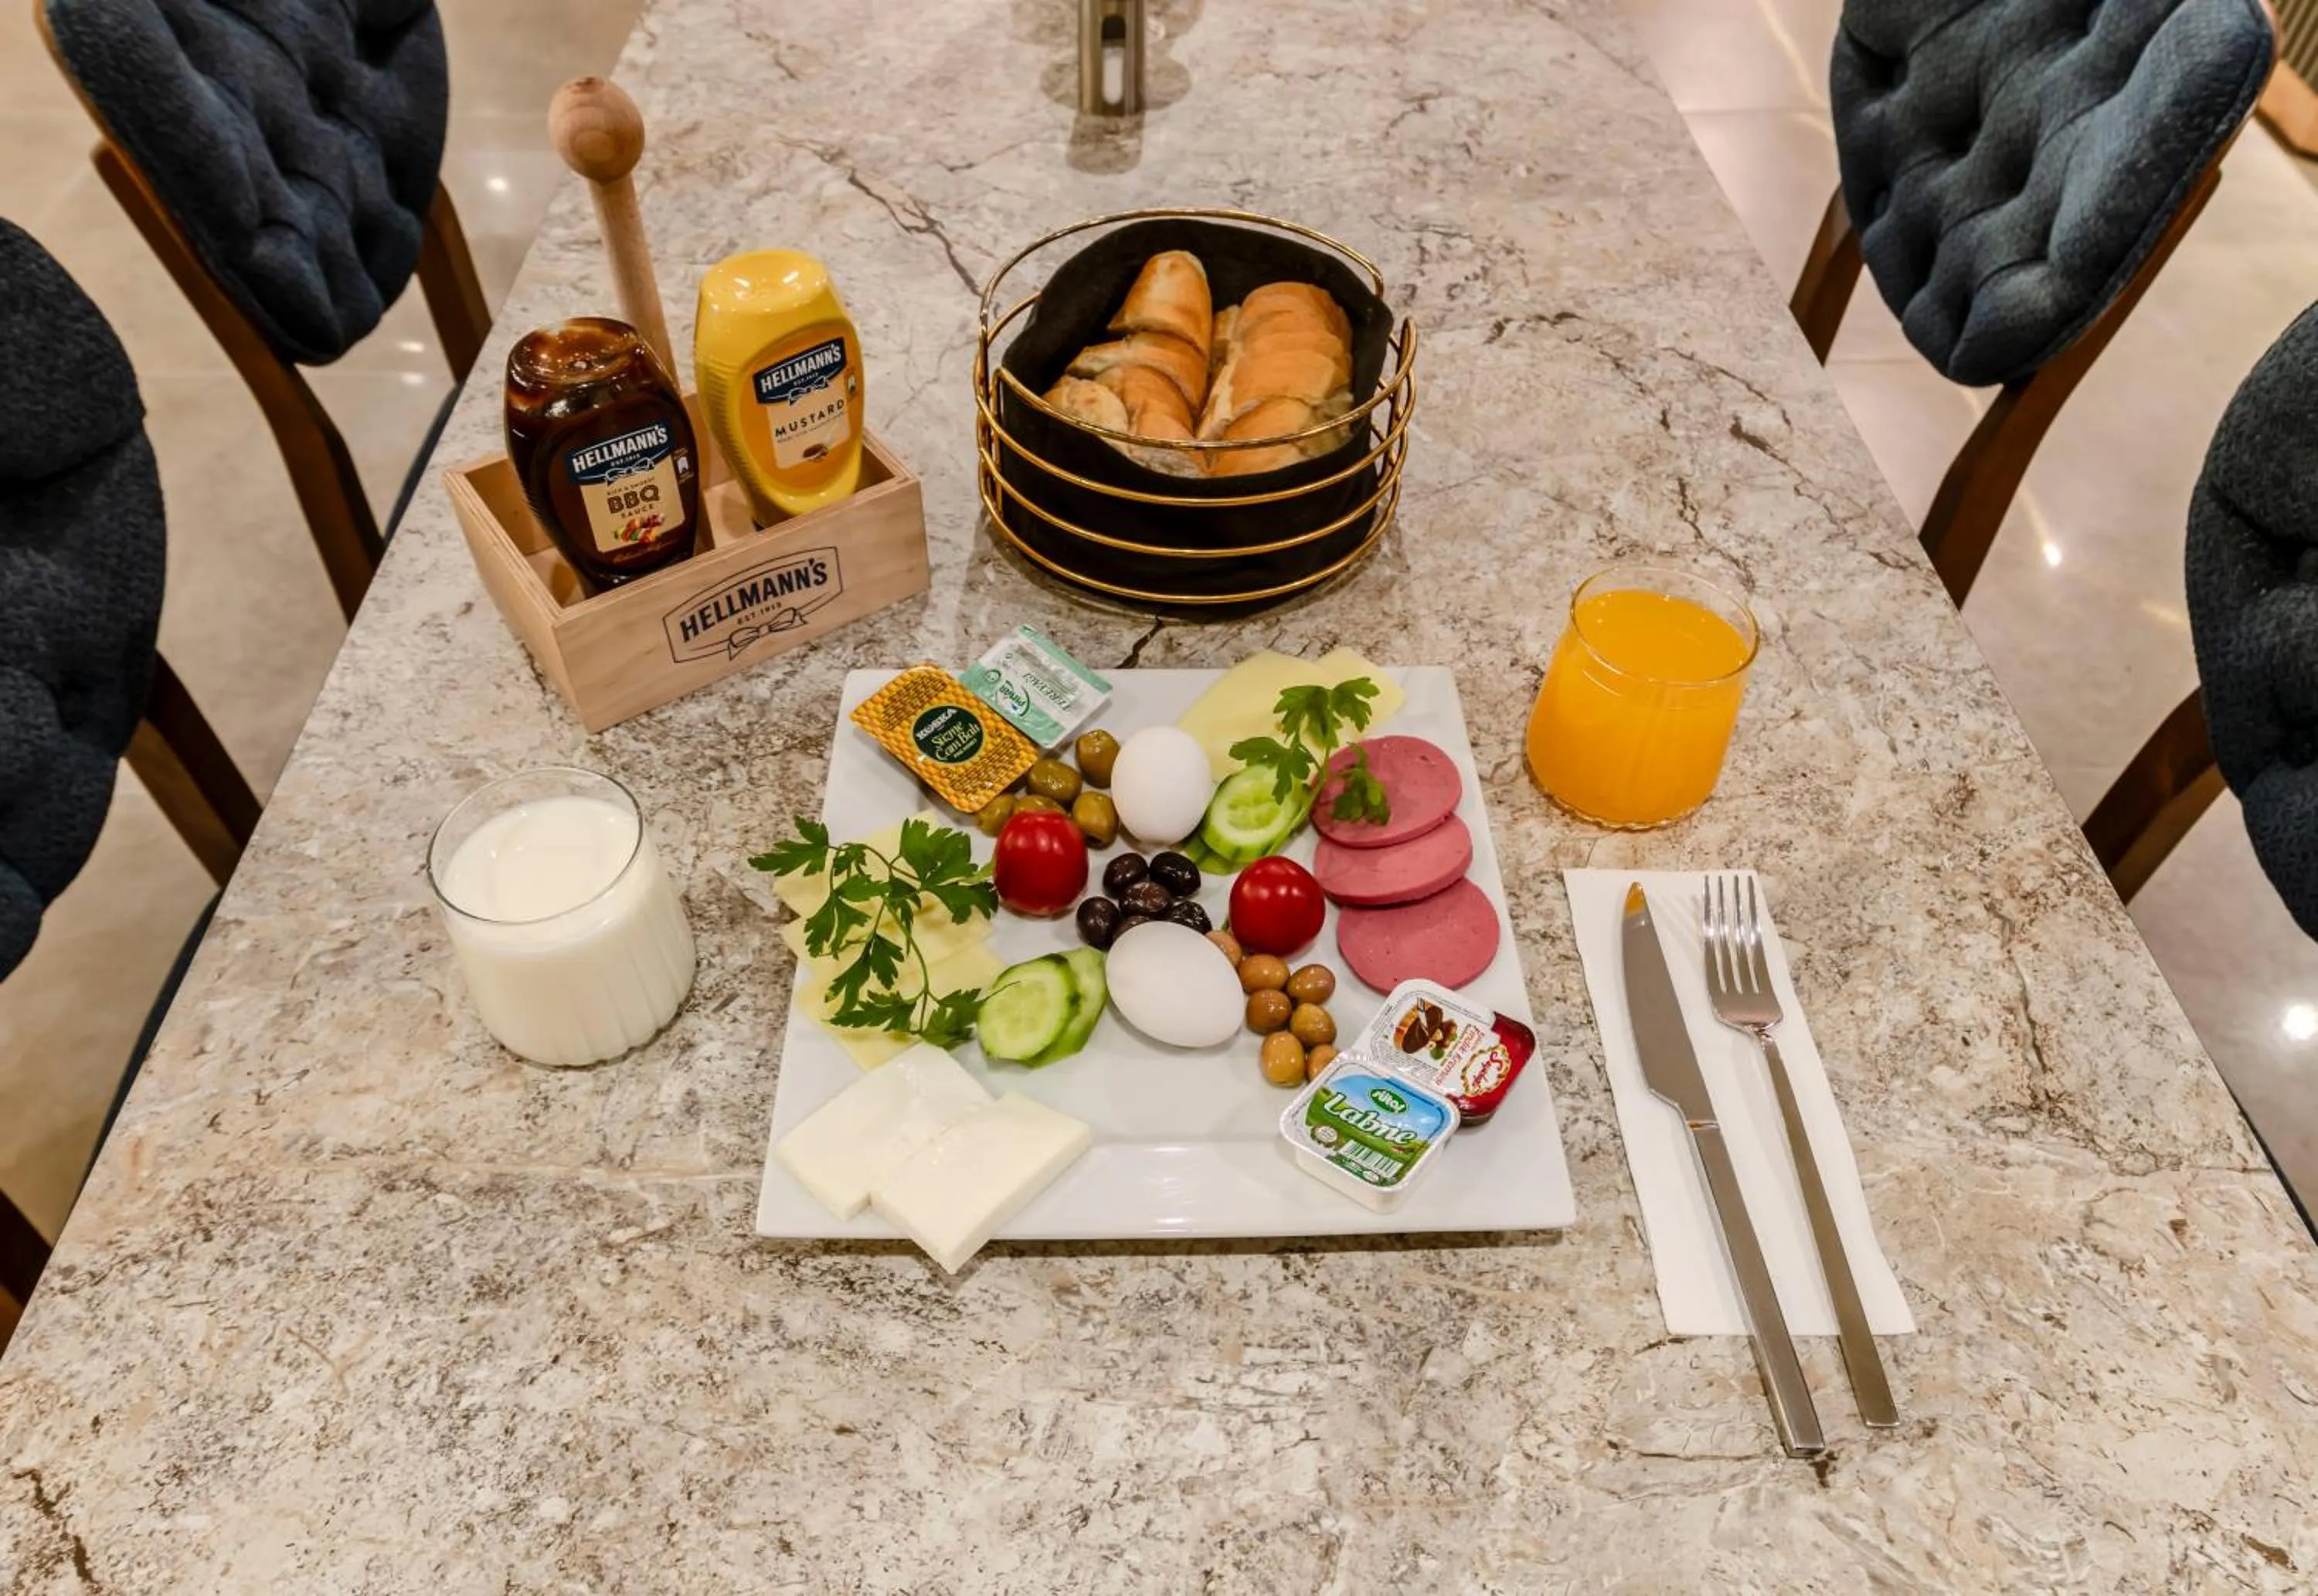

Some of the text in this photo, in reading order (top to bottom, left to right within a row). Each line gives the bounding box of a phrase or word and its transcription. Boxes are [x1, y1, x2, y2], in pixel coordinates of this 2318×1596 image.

[760, 344, 841, 393] HELLMANN'S
[775, 399, 845, 437] MUSTARD
[572, 425, 668, 473] HELLMANN'S
[607, 484, 661, 514] BBQ
[679, 558, 828, 643] HELLMANN'S
[1324, 1092, 1418, 1146] Labne
